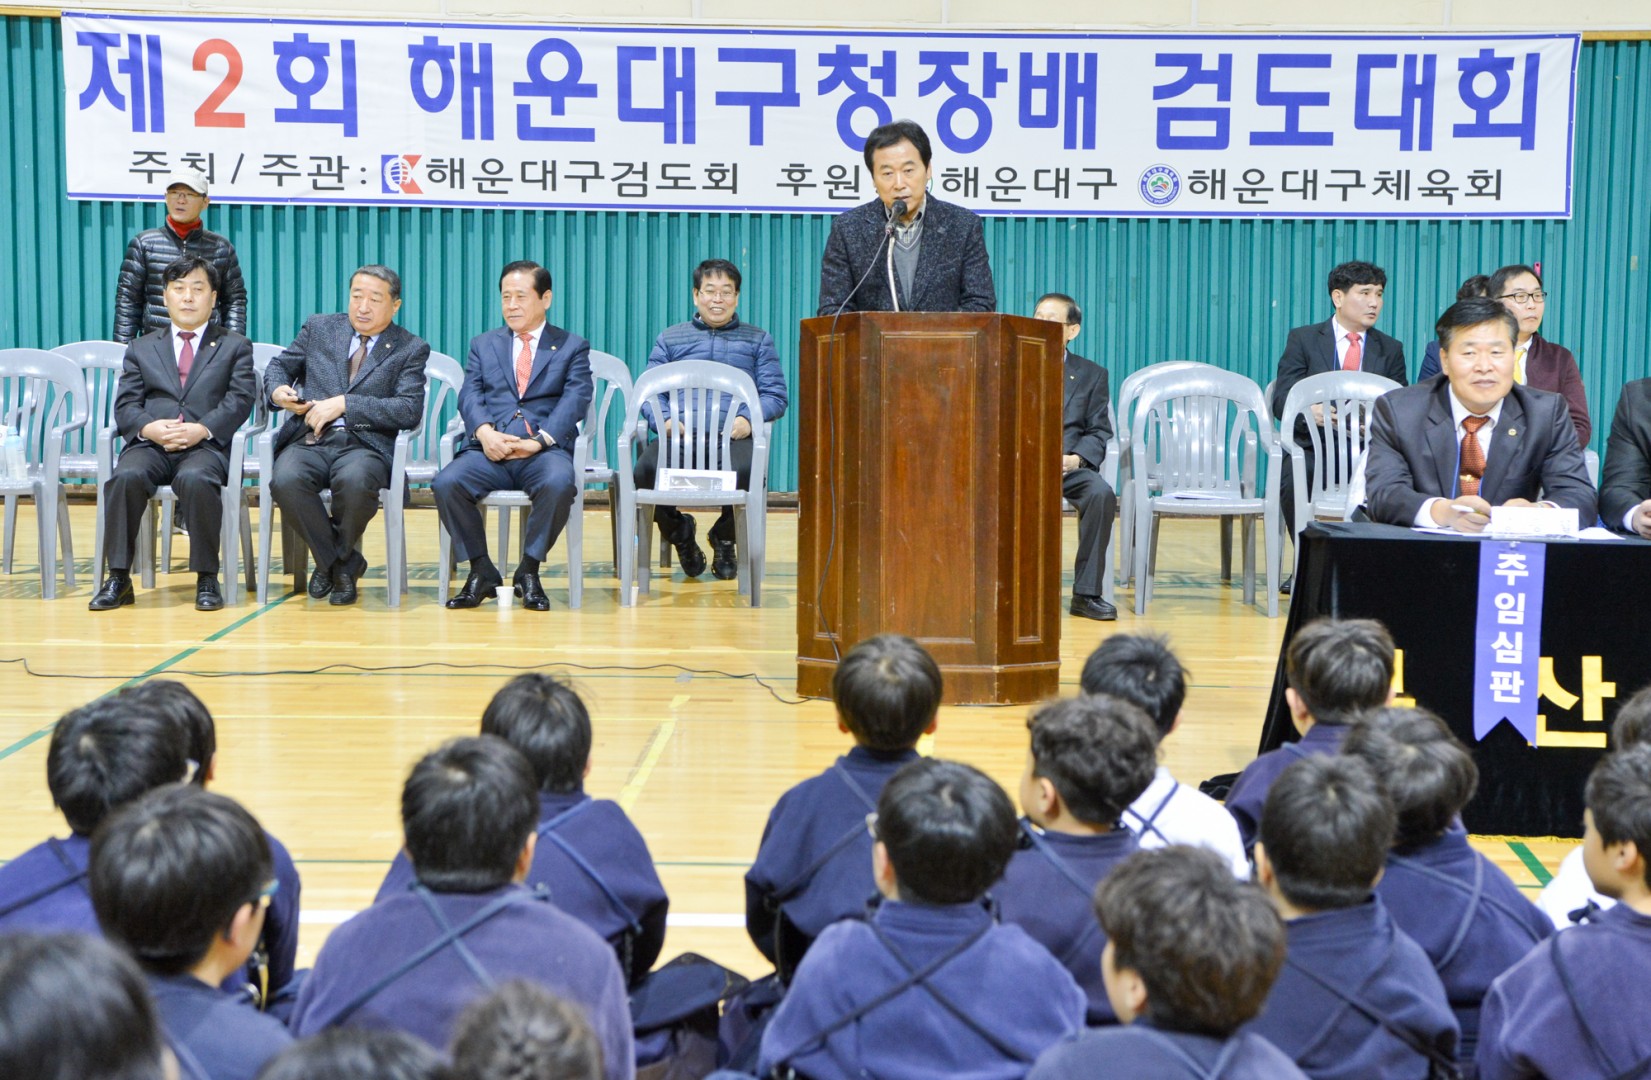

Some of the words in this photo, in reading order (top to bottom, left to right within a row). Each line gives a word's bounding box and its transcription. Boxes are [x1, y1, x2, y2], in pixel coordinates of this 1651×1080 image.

[408, 35, 1098, 154] 해운대구청장배
[1152, 48, 1540, 152] 검도대회
[426, 157, 738, 197] 해운대구검도회
[776, 163, 860, 200] 후원
[940, 166, 1117, 203] 해운대구
[1187, 168, 1502, 206] 해운대구체육회
[1489, 553, 1529, 704] 주임심판
